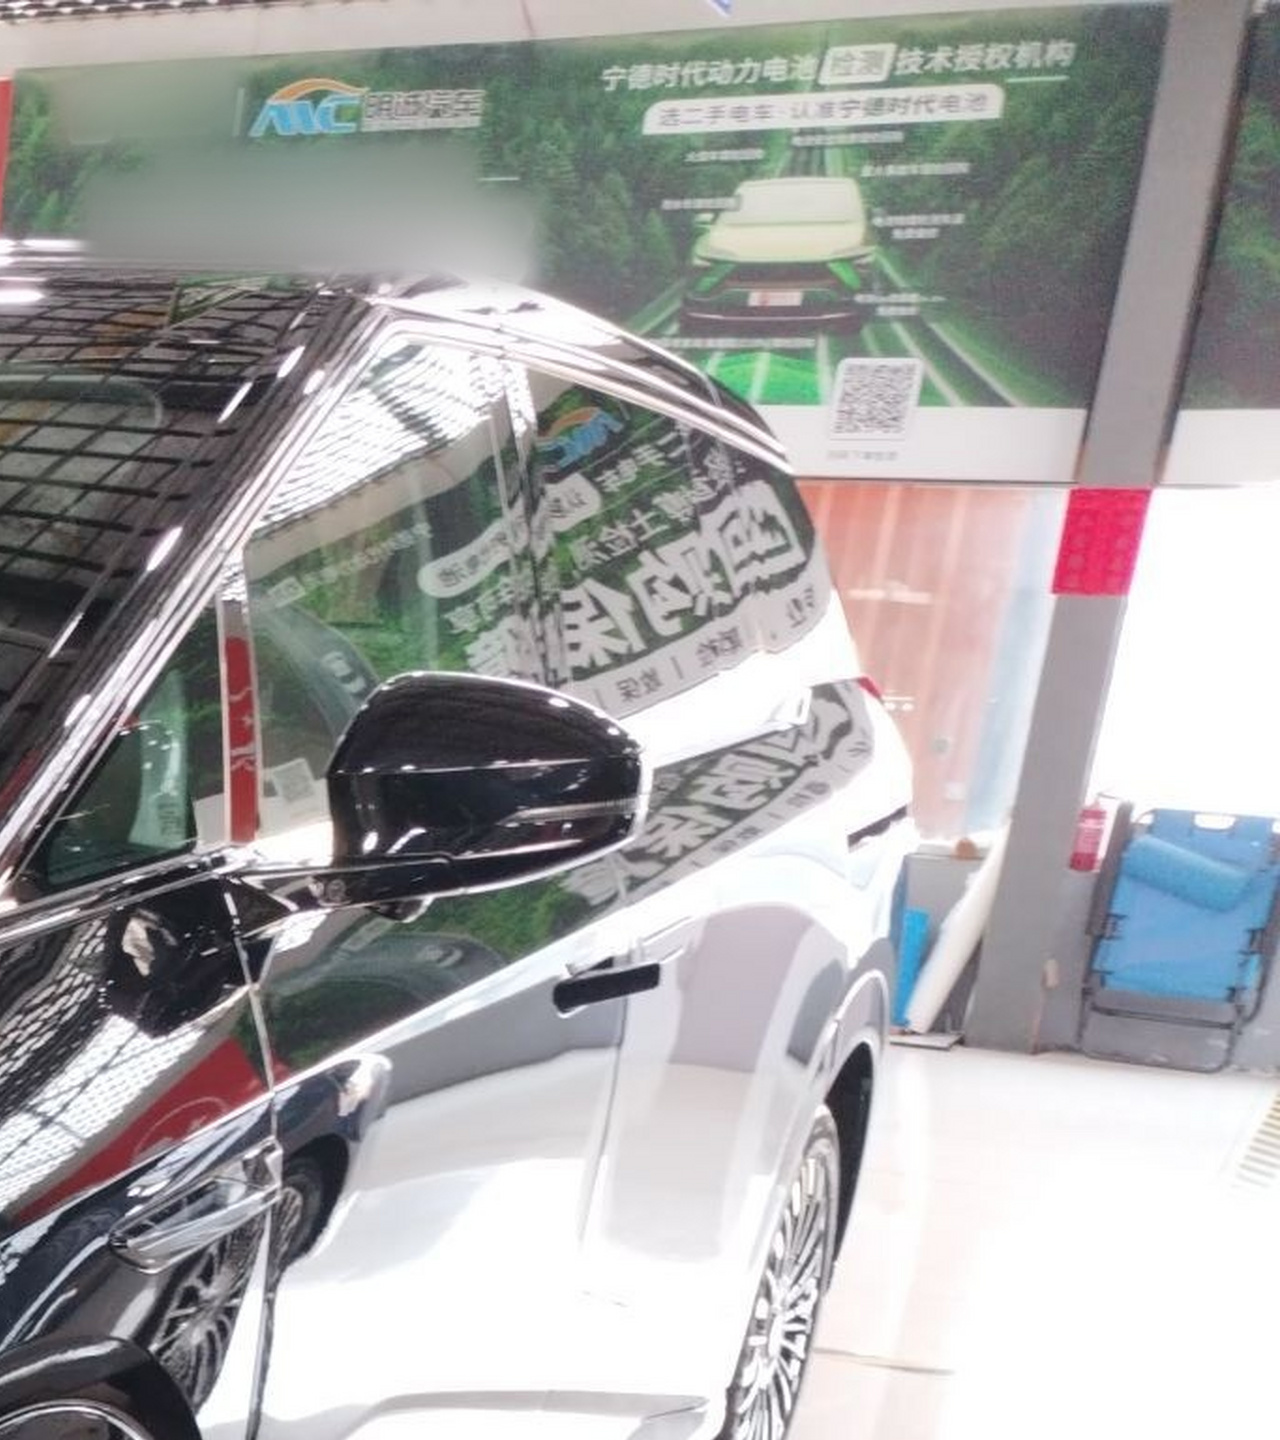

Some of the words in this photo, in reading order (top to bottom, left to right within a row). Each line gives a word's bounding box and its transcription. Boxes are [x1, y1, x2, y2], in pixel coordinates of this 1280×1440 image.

[601, 54, 819, 91] 宁德时代动力电池
[895, 39, 1077, 76] 技术授权机构
